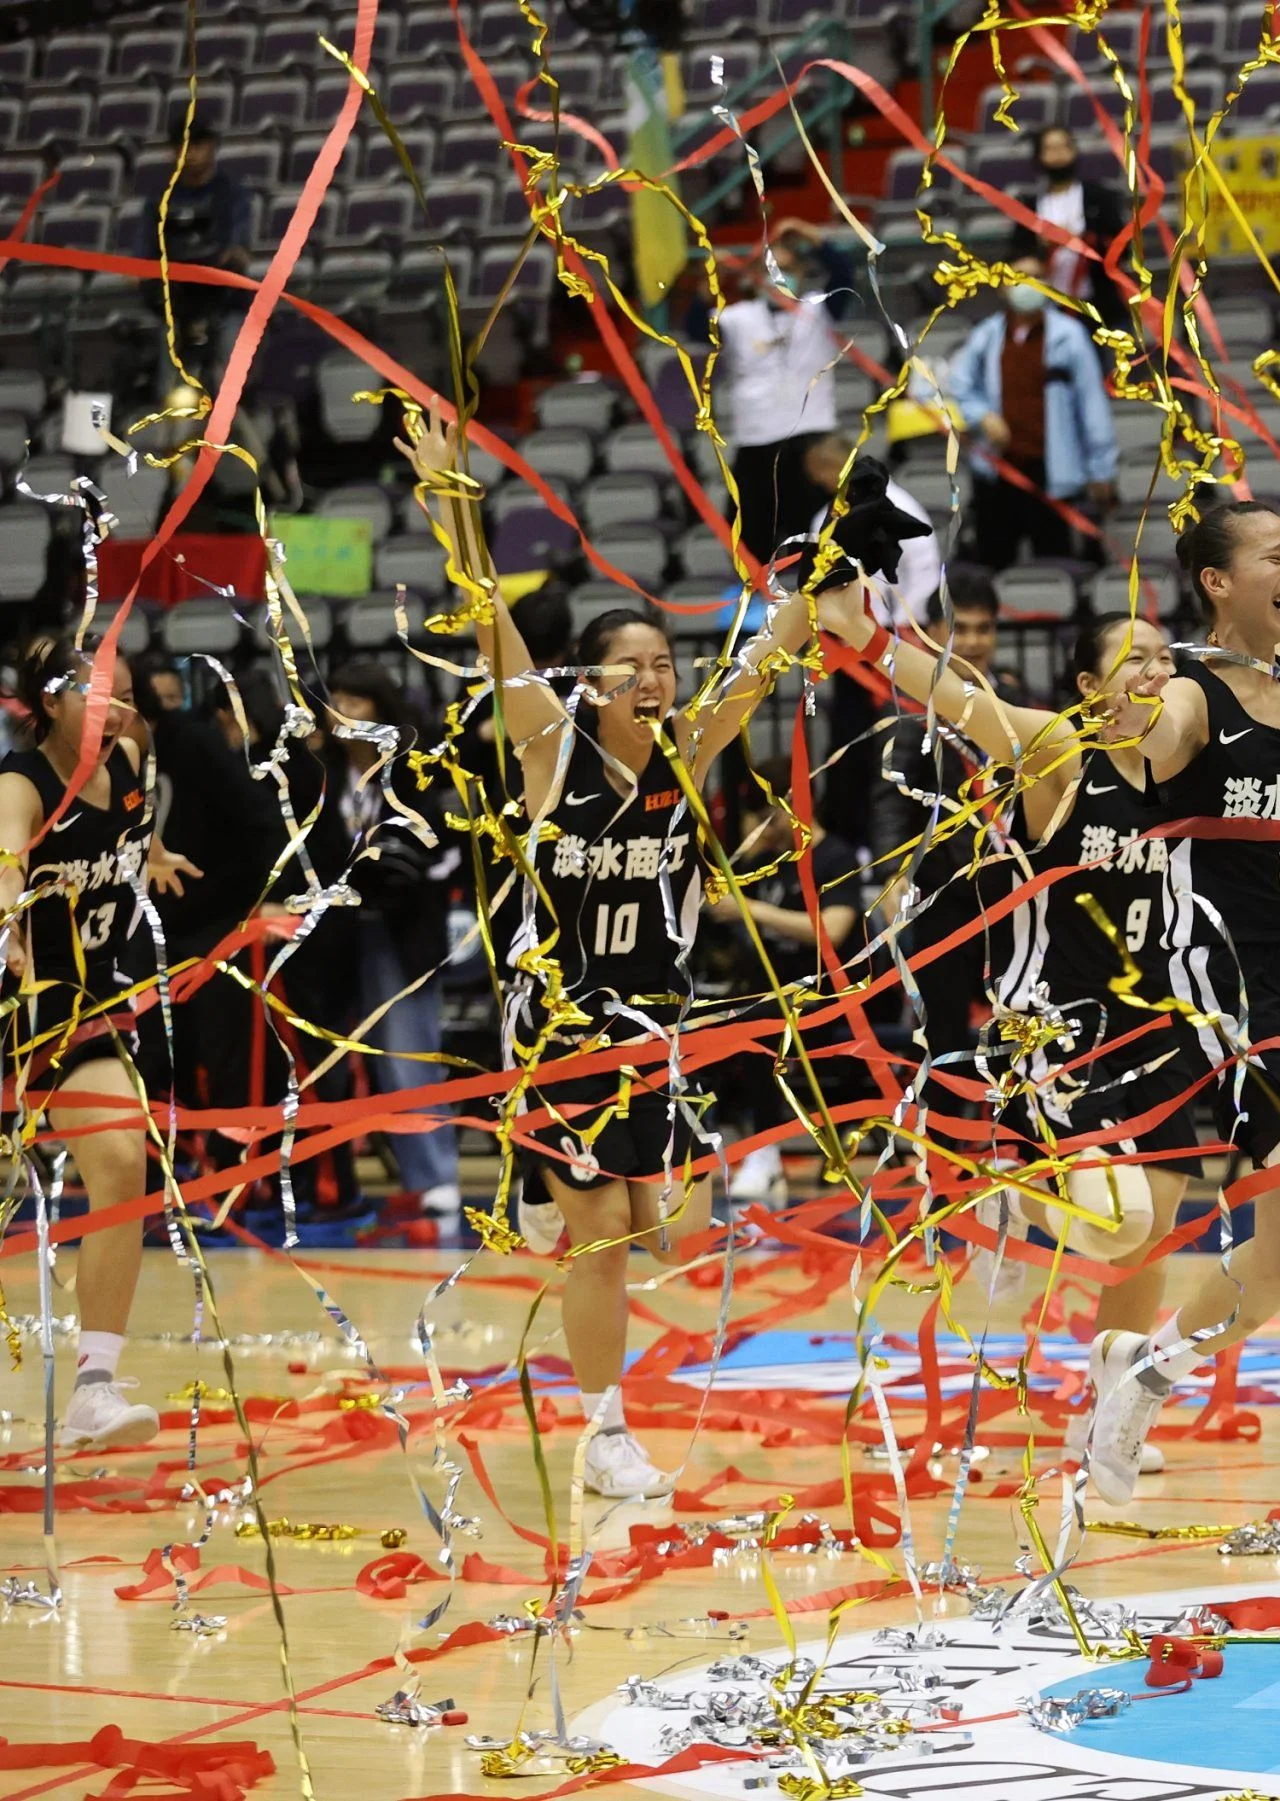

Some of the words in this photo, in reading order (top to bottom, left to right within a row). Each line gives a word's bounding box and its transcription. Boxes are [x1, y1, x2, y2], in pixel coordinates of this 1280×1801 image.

[80, 902, 118, 950] 13
[594, 902, 640, 956] 10
[1125, 898, 1152, 953] 9
